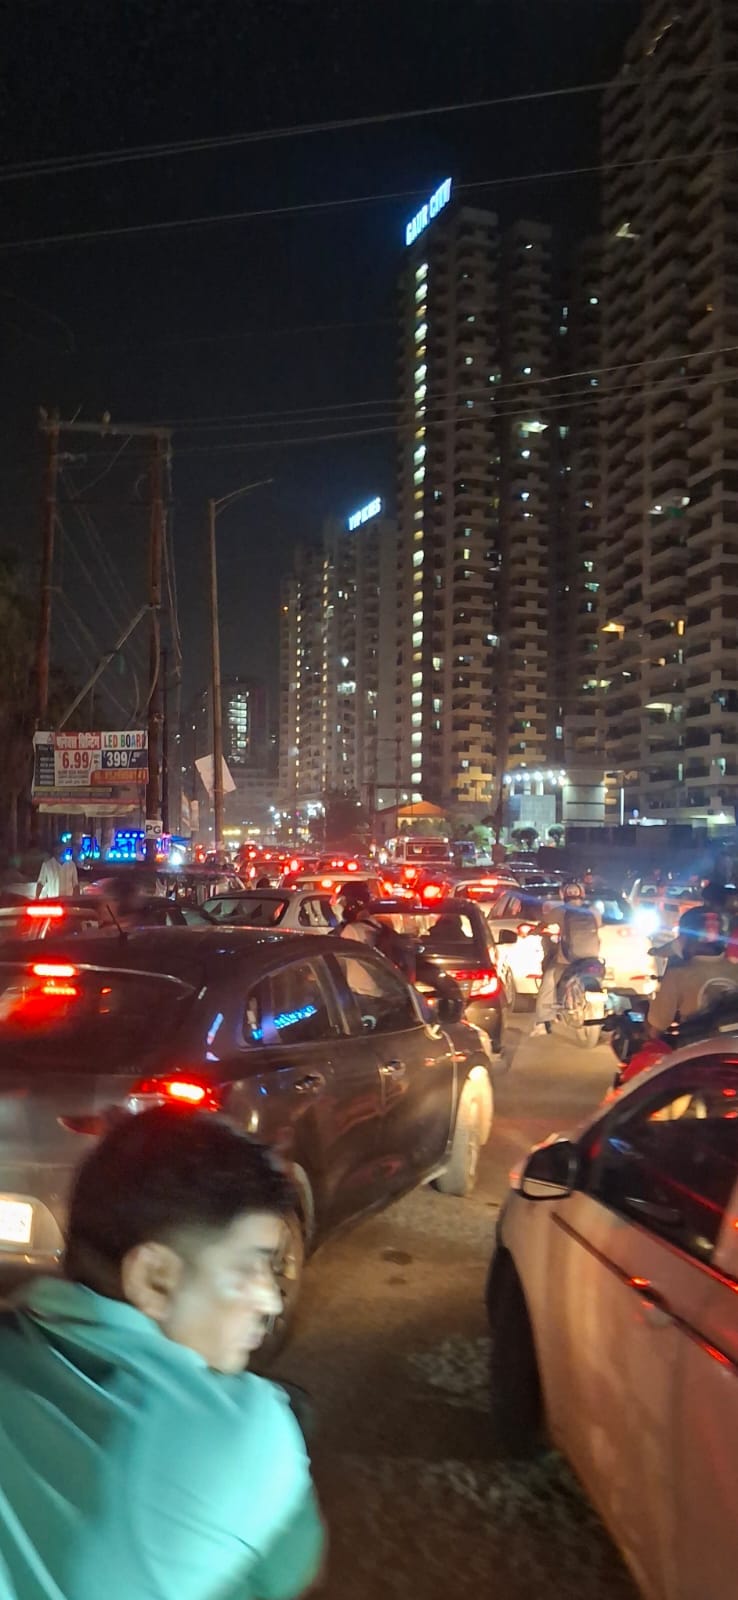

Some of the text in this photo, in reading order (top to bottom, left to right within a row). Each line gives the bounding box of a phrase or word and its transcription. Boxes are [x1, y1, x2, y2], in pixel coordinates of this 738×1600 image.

[406, 176, 452, 246] GAUR CITY
[104, 734, 146, 748] LED BOARD
[146, 824, 161, 834] PG
